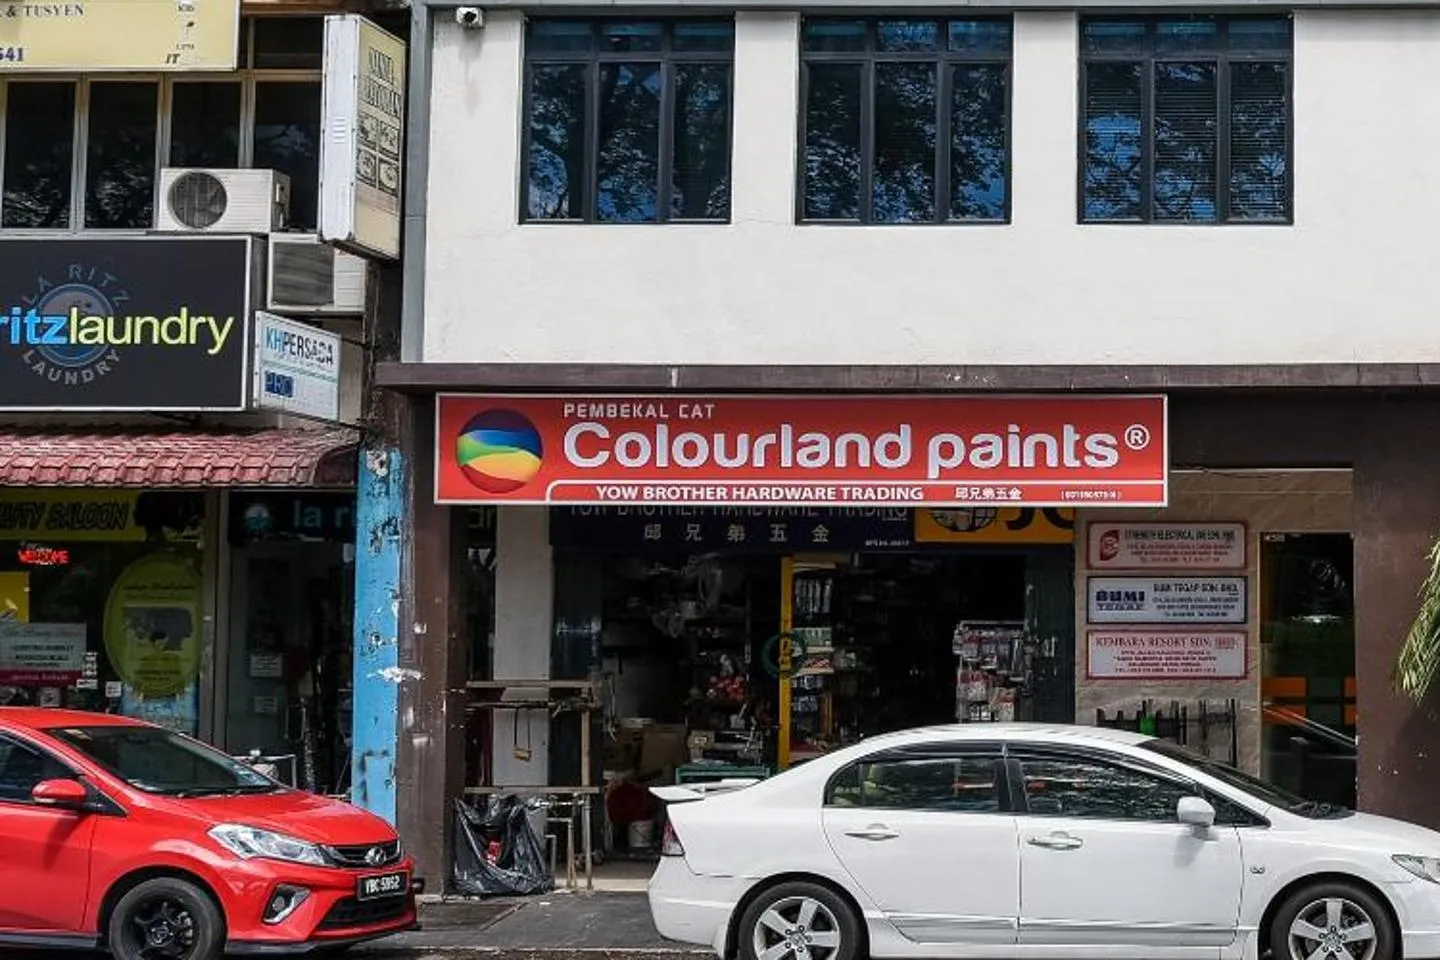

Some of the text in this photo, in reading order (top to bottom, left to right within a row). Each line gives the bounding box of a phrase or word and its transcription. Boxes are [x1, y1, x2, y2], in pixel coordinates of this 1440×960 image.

[24, 3, 84, 17] TUSYEN
[21, 348, 121, 385] LAUNDRY
[564, 404, 715, 419] PEMBEKAL CAT
[564, 422, 911, 468] Colourland
[597, 486, 924, 501] YOW BROTHER HARDWARE TRADING
[46, 501, 129, 530] SALOON
[1096, 591, 1145, 602] BUMI
